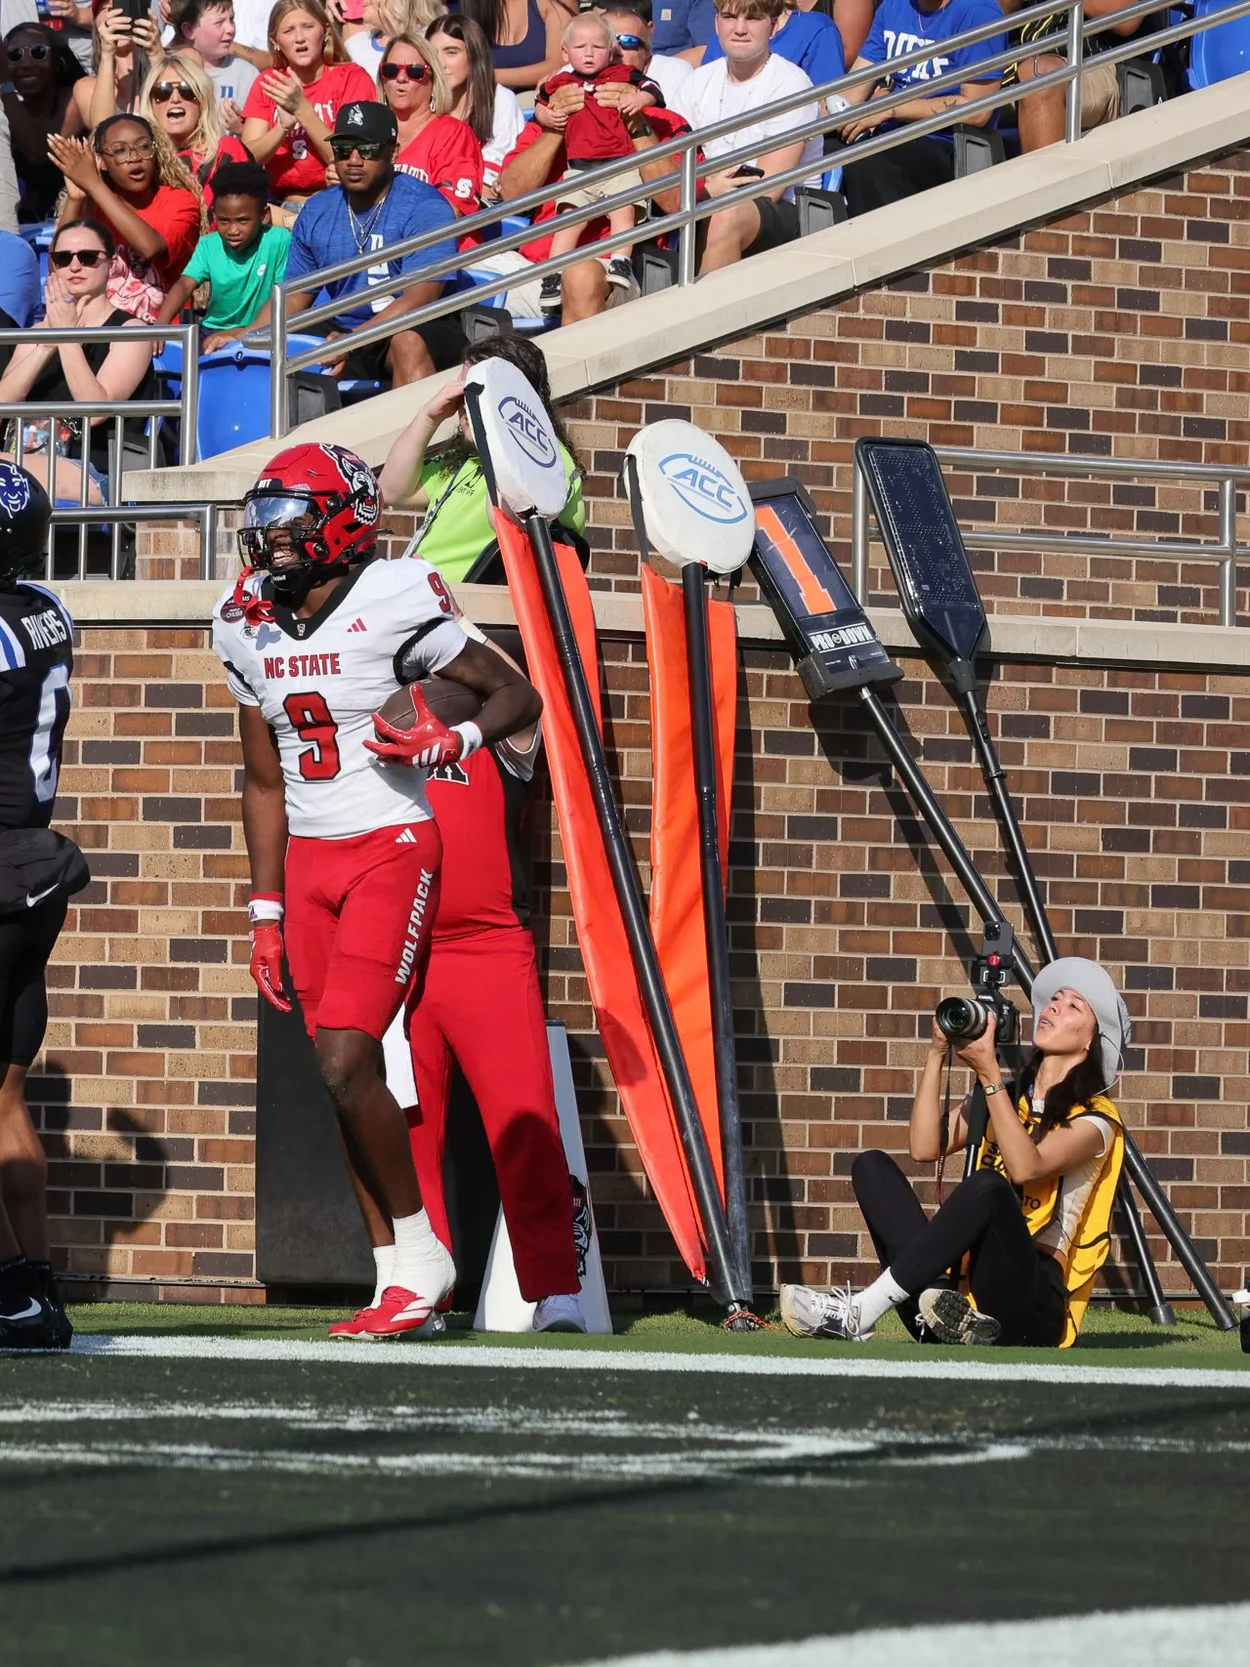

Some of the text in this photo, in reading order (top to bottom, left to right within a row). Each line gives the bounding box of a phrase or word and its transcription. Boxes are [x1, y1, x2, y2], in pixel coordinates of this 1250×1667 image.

[508, 411, 549, 452] ACC
[673, 467, 737, 509] ACC
[755, 504, 837, 616] 1
[427, 571, 451, 613] 9
[20, 608, 68, 651] RIVERS
[809, 624, 874, 652] PRO DOWN
[264, 652, 342, 680] NC STATE
[282, 690, 342, 782] 9
[394, 867, 434, 985] WOLFPACK
